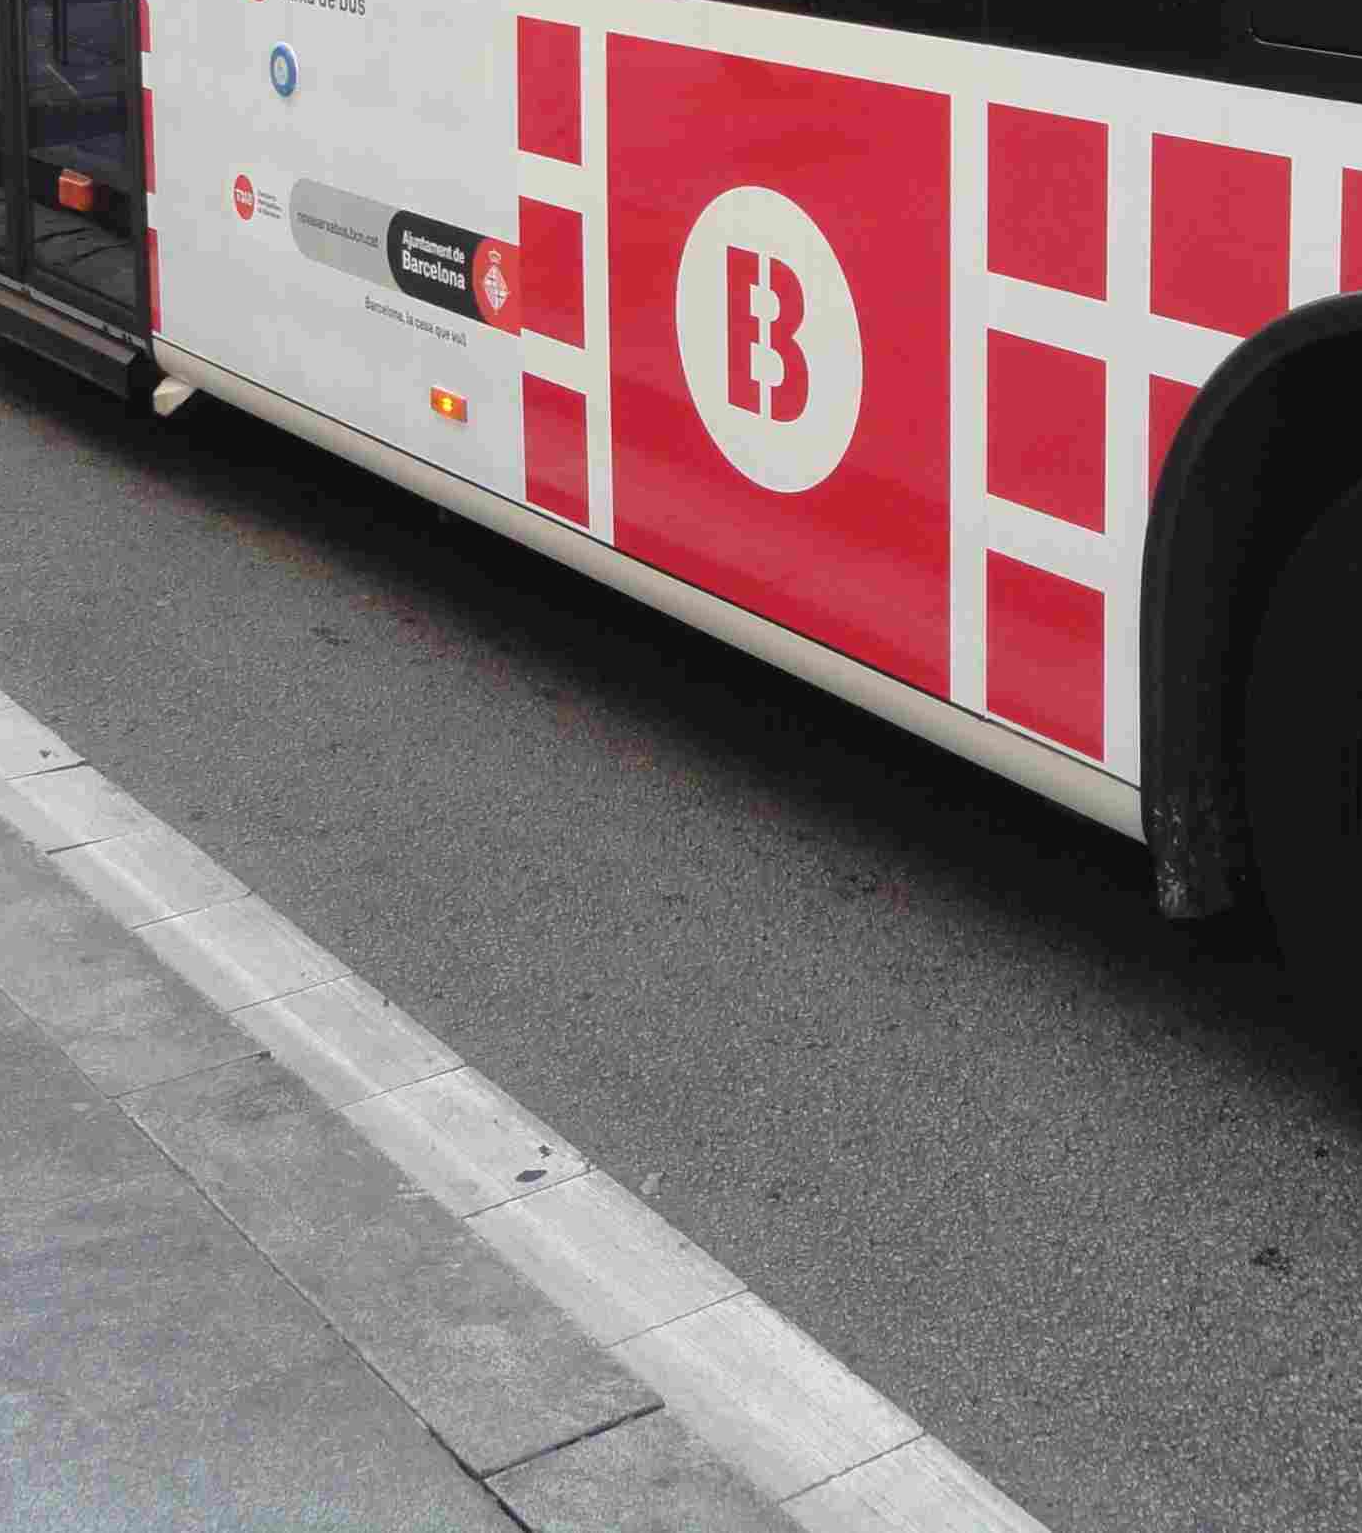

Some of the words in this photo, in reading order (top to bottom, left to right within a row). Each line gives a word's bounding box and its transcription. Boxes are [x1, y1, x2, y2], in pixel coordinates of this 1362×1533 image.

[402, 229, 449, 262] Ajuntament
[449, 246, 466, 265] de
[401, 250, 467, 292] Barcelona
[727, 243, 810, 424] B
